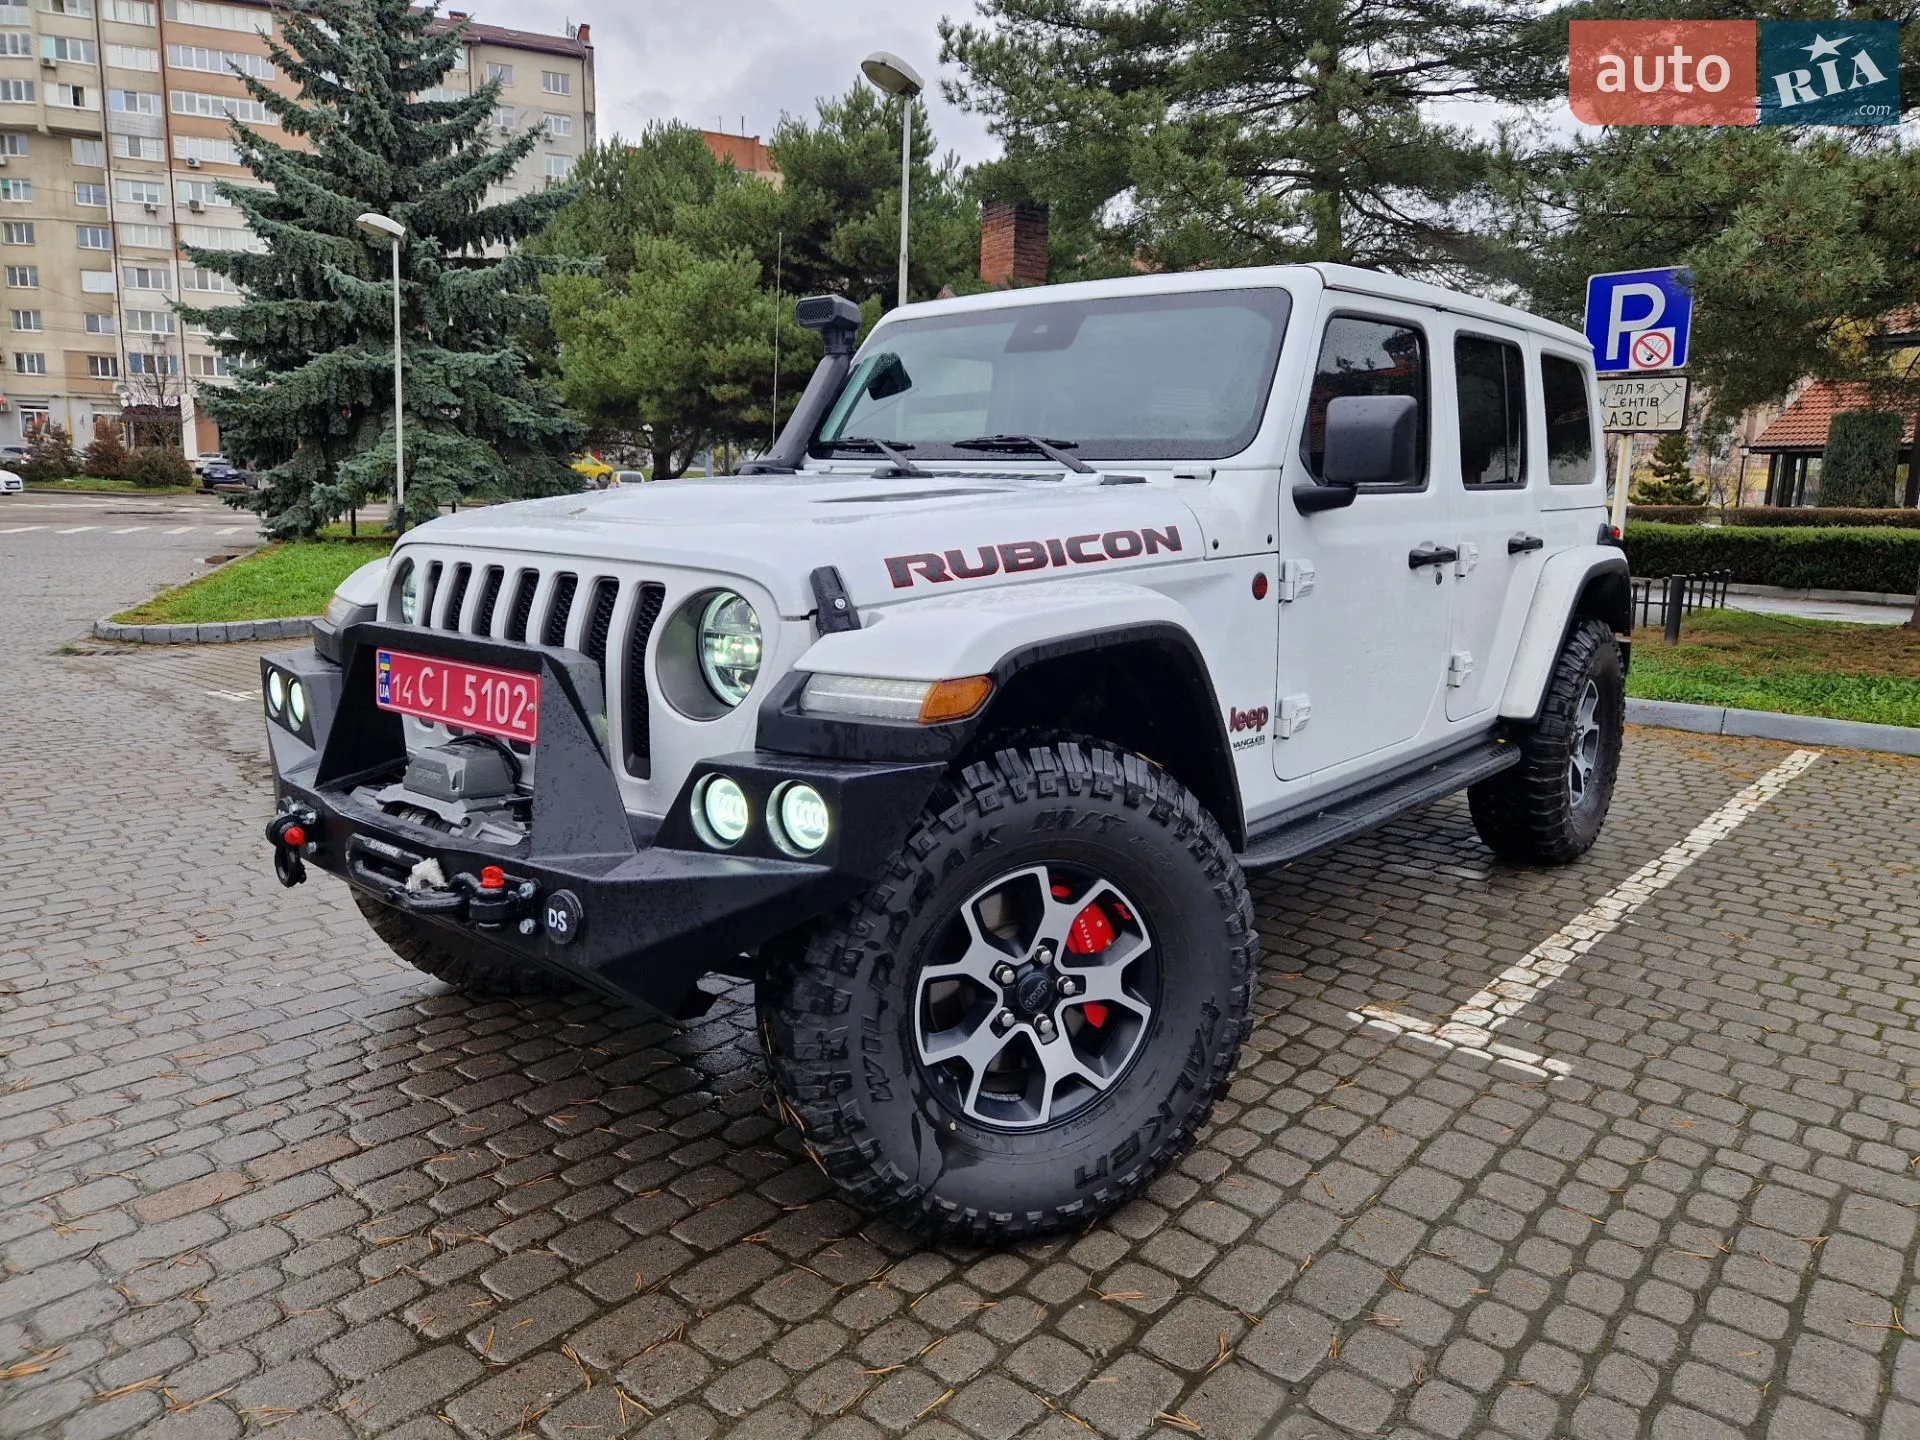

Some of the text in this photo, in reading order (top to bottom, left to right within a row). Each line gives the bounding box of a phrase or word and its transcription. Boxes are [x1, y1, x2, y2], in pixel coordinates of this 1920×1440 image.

[1606, 282, 1666, 361] P
[1614, 383, 1645, 396] ДЛЯ
[1609, 411, 1648, 427] АЗС
[884, 525, 1183, 589] RUBICON
[379, 683, 390, 699] UA
[462, 674, 528, 730] 5102
[1229, 706, 1269, 733] Jeep
[548, 908, 568, 932] DS
[1024, 979, 1048, 1008] Jeep
